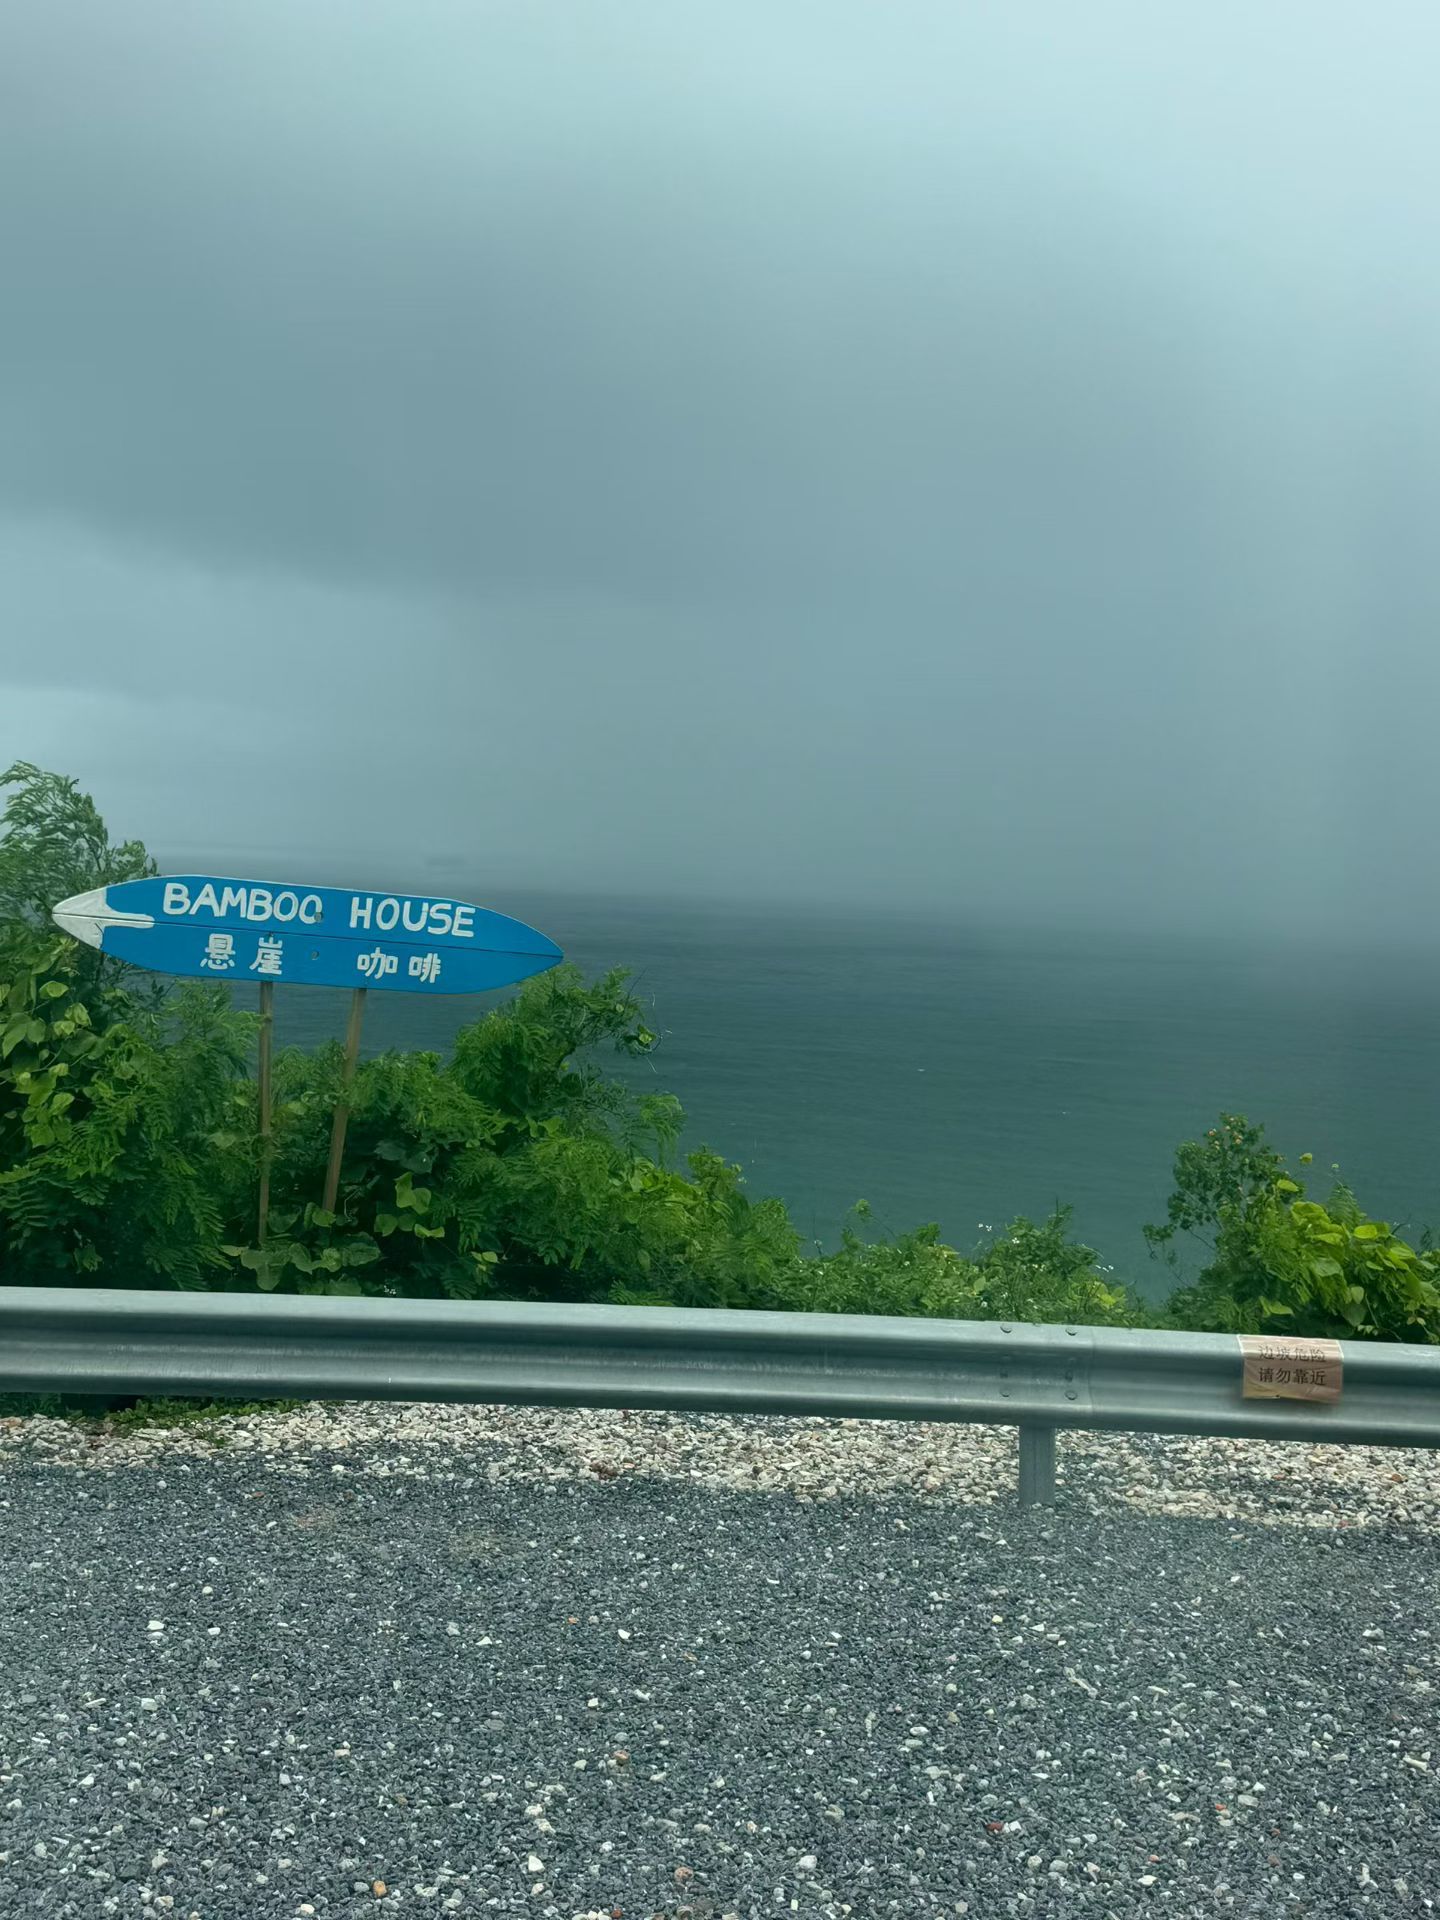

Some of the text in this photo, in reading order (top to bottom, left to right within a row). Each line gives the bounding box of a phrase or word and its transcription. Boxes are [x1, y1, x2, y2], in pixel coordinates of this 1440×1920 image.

[163, 882, 476, 938] BAMBOO HOUSE
[200, 931, 441, 984] 悬崖 咖啡
[1258, 1367, 1327, 1386] 请勿靠近
